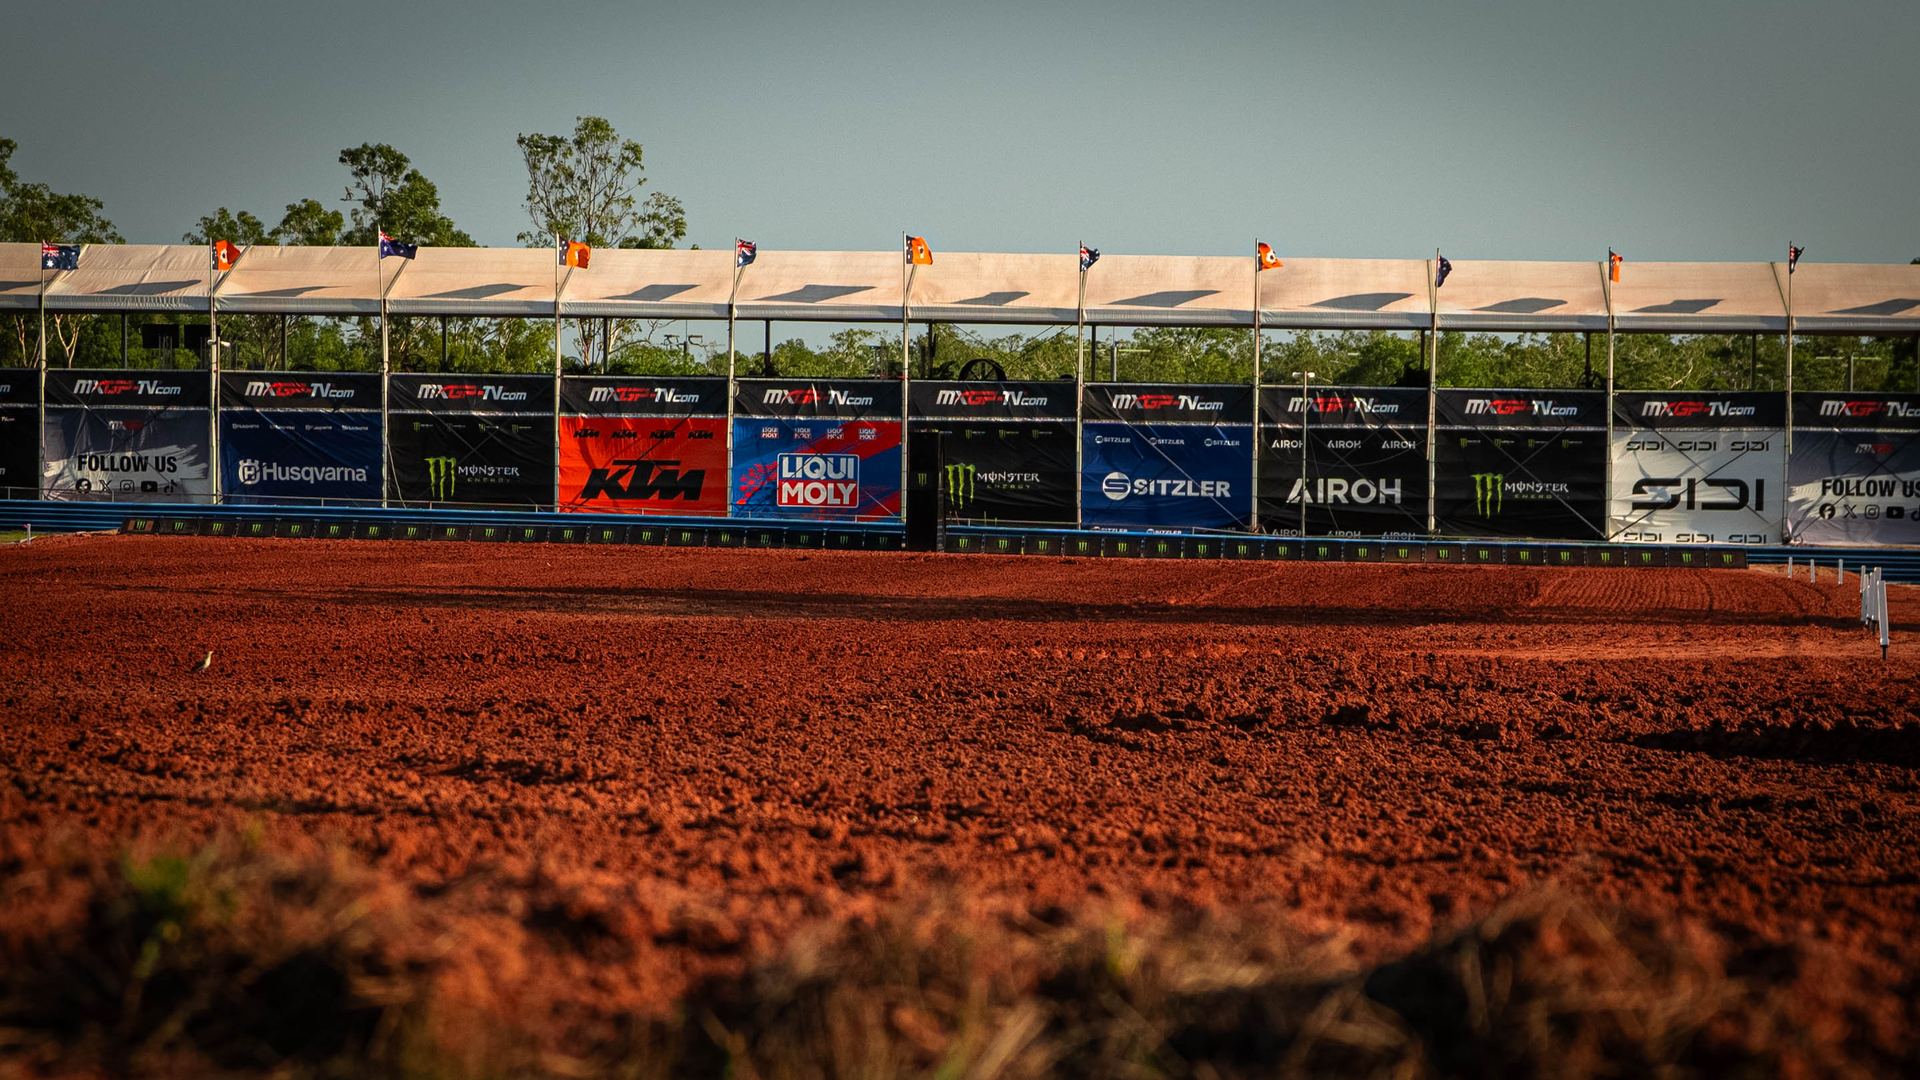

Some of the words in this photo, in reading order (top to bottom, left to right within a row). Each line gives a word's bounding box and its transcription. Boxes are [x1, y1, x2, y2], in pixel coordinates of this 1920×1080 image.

[574, 429, 599, 438] KTM
[611, 429, 637, 439] KTM
[650, 429, 676, 439] KTM
[688, 430, 713, 439] KTM
[1328, 440, 1361, 449] AIROH
[1381, 440, 1416, 450] AIROH
[1626, 441, 1664, 451] SIDI
[1678, 441, 1717, 451] SIDI
[1731, 441, 1769, 452] SIDI
[77, 454, 149, 472] FOLLOW
[155, 456, 177, 472] US
[458, 465, 520, 477] MONSTER
[782, 457, 854, 480] LIQUI
[263, 462, 367, 484] Husqvarna
[580, 459, 705, 500] KTM
[976, 471, 1040, 483] MONSTER
[781, 482, 856, 505] MOLY
[1133, 479, 1231, 498] SITZLER
[1286, 478, 1401, 504] AIROH
[1504, 481, 1569, 493] MONSTER
[1632, 478, 1764, 511] SIDI
[1822, 479, 1896, 497] FOLLOW
[1902, 480, 1920, 497] US
[1624, 532, 1662, 542] SIDI
[1676, 533, 1714, 543] SIDI
[1728, 534, 1767, 544] SIDI
